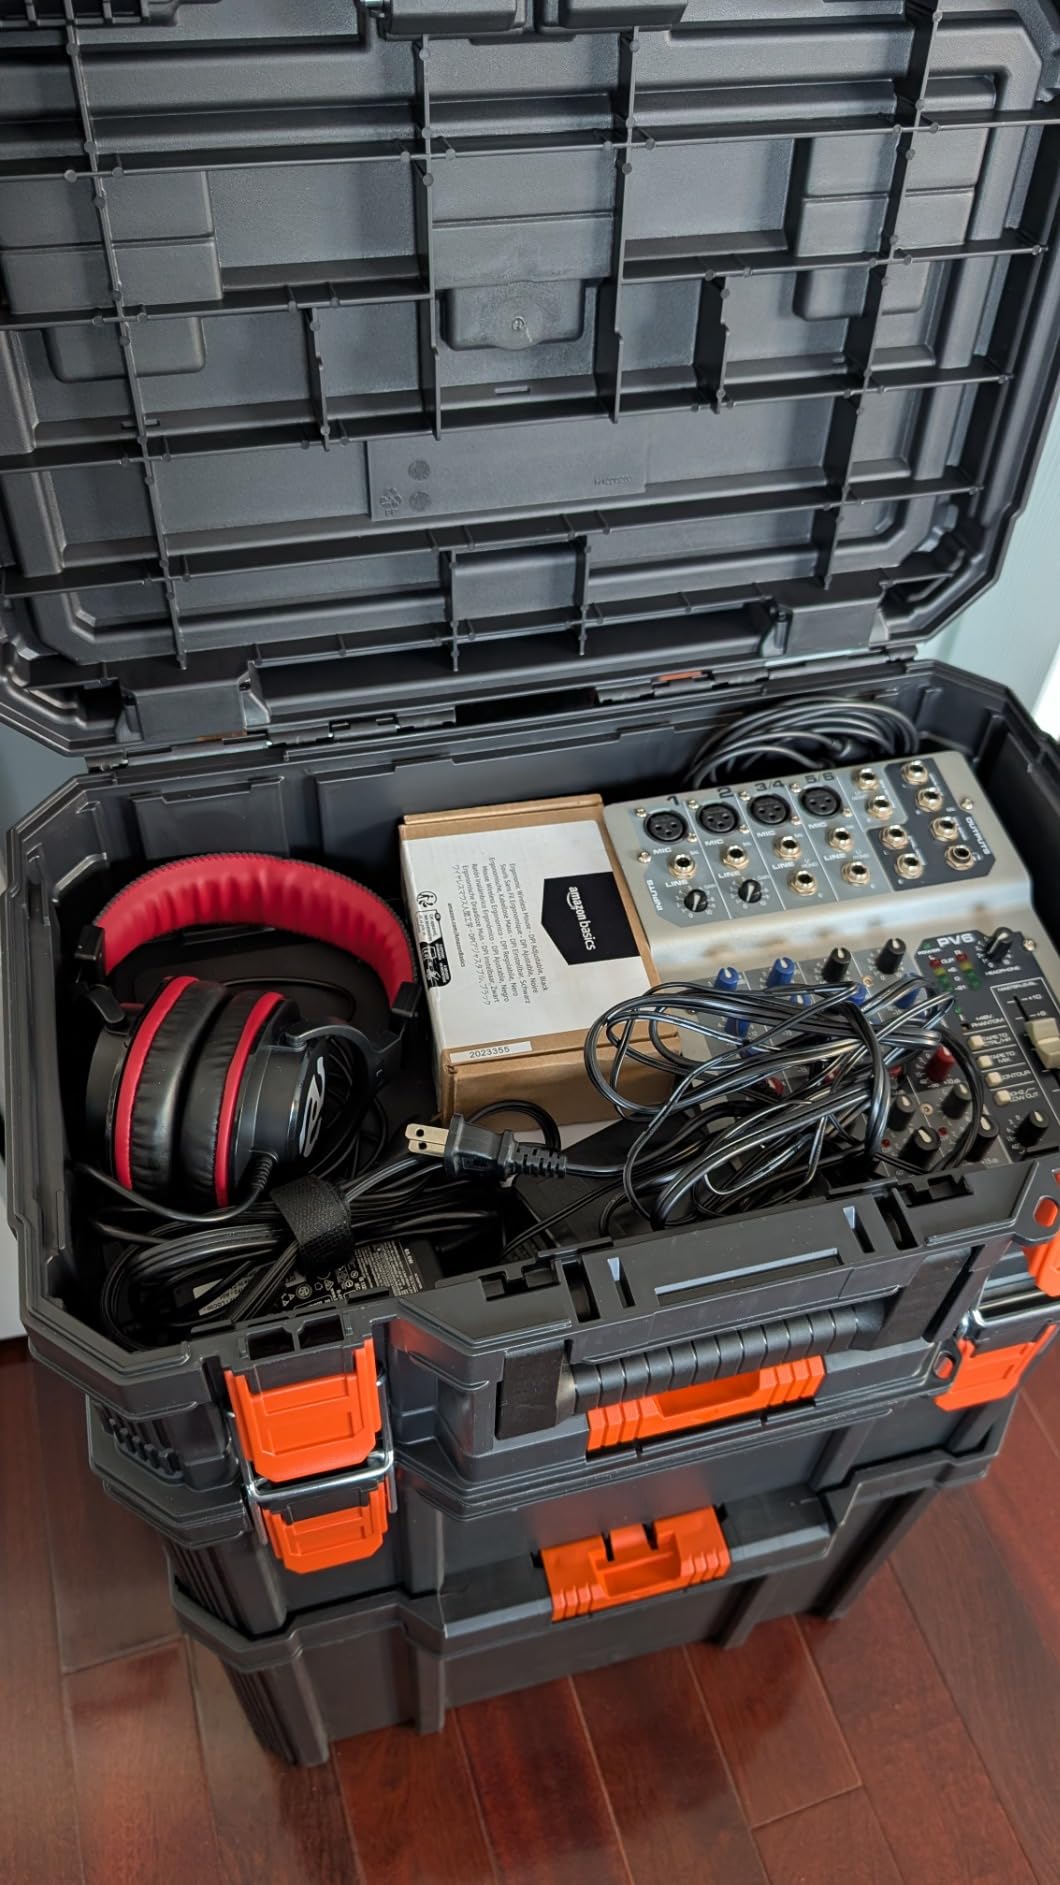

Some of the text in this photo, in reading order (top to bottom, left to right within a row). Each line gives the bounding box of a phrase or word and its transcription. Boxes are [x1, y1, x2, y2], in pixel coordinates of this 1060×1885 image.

[805, 772, 834, 783] 5/6
[755, 780, 784, 791] 3/4
[717, 787, 734, 798] 2
[667, 796, 679, 806] 1
[757, 830, 776, 838] MIC
[965, 816, 991, 855] OUTPUTS
[705, 838, 724, 846] MIC
[823, 853, 846, 862] LINE
[772, 861, 795, 870] LINE
[718, 870, 741, 879] LINE
[665, 879, 688, 888] LINE
[646, 880, 663, 911] INPUTS
[567, 887, 596, 951] amazon basics
[937, 933, 975, 948] PV6
[499, 983, 510, 1002] Negro
[469, 1046, 510, 1059] 2023355
